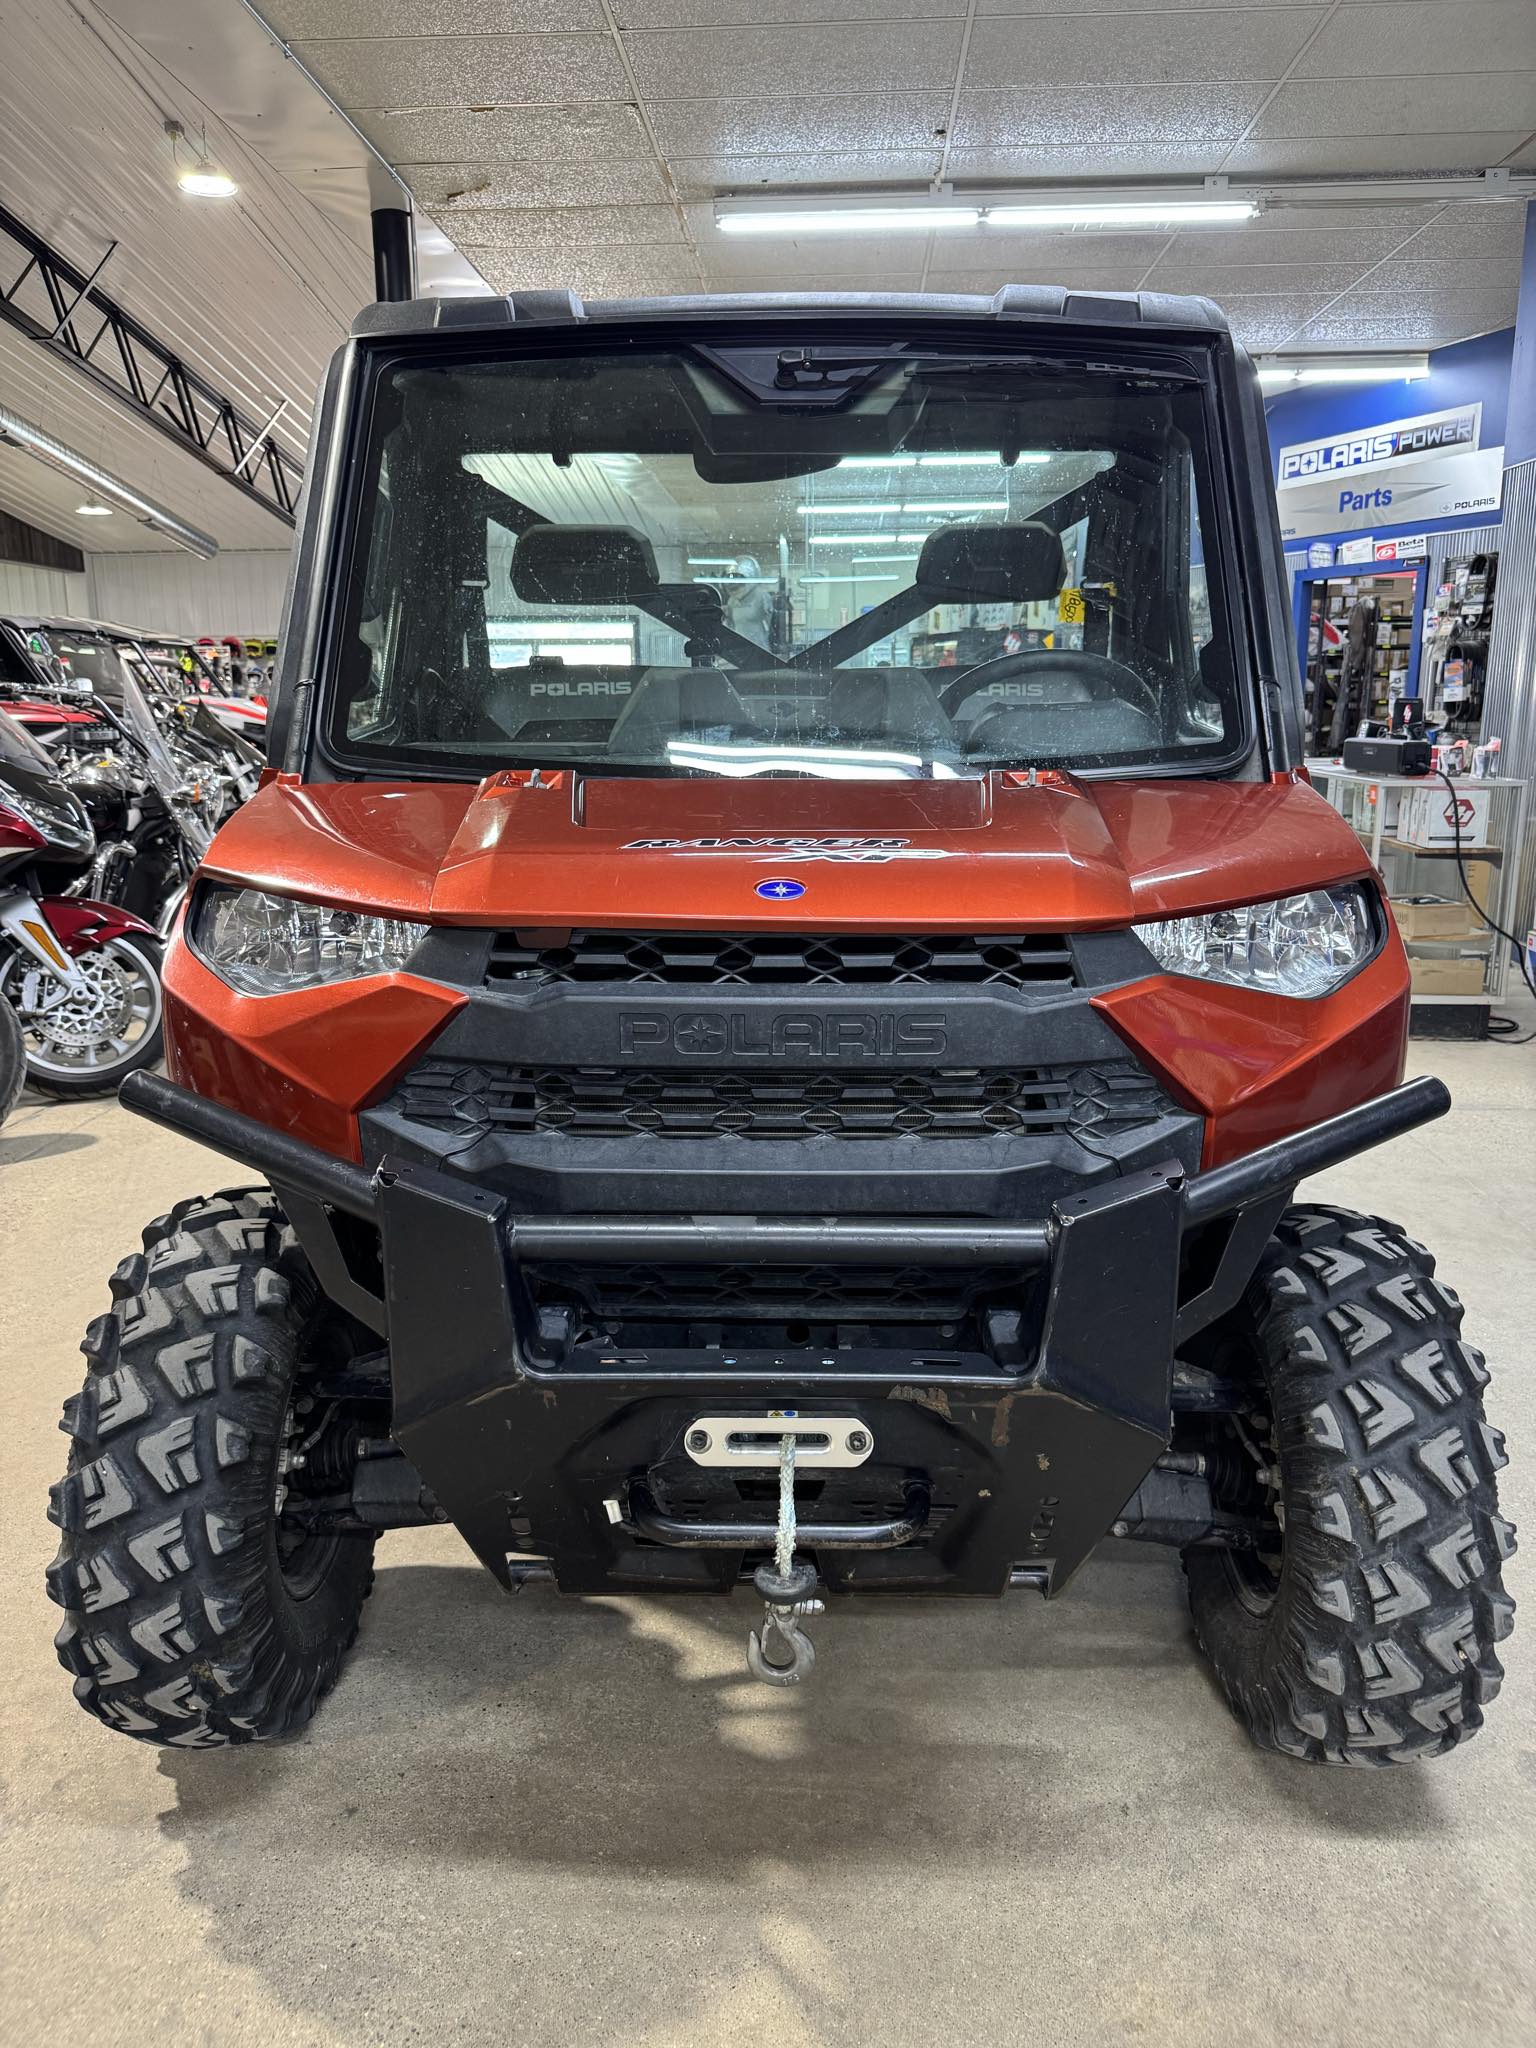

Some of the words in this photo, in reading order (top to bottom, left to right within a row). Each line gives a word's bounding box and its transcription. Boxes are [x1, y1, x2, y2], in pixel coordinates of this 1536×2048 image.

[1283, 434, 1397, 479] POLARIS
[1399, 418, 1474, 452] POWER
[1339, 488, 1392, 513] Parts
[1454, 497, 1496, 510] POLARIS
[530, 681, 633, 697] POLARIS
[617, 838, 913, 850] RANGER
[619, 1012, 947, 1056] POLARIS
